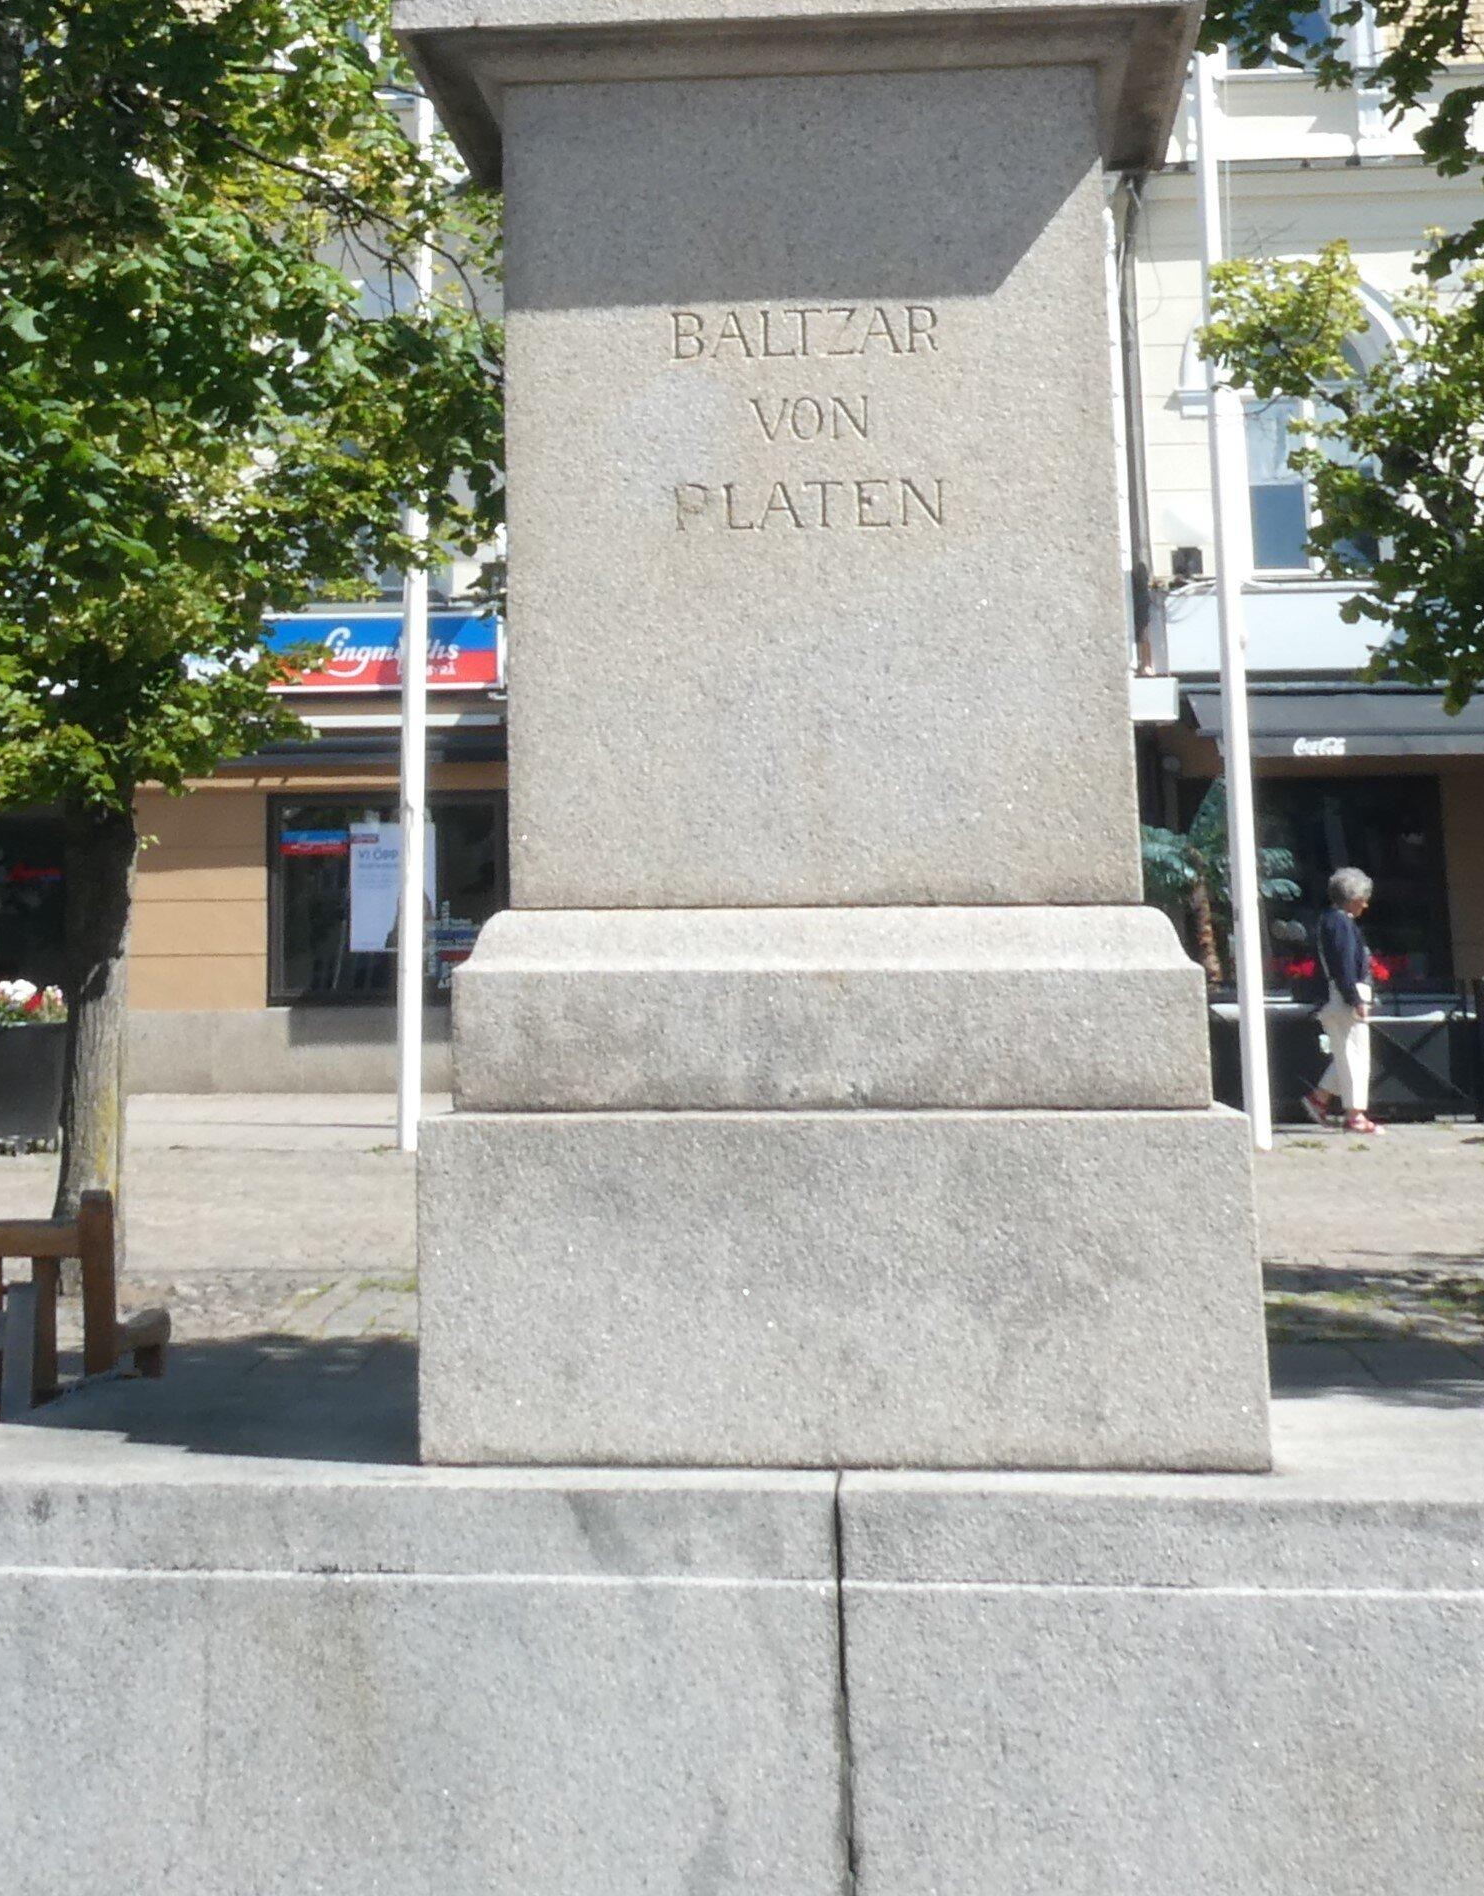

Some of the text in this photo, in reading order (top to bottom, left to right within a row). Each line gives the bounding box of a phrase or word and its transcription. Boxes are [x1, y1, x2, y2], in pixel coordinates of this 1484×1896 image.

[670, 305, 939, 360] BALTZAR
[749, 394, 868, 442] VON
[672, 478, 945, 531] PLATEN
